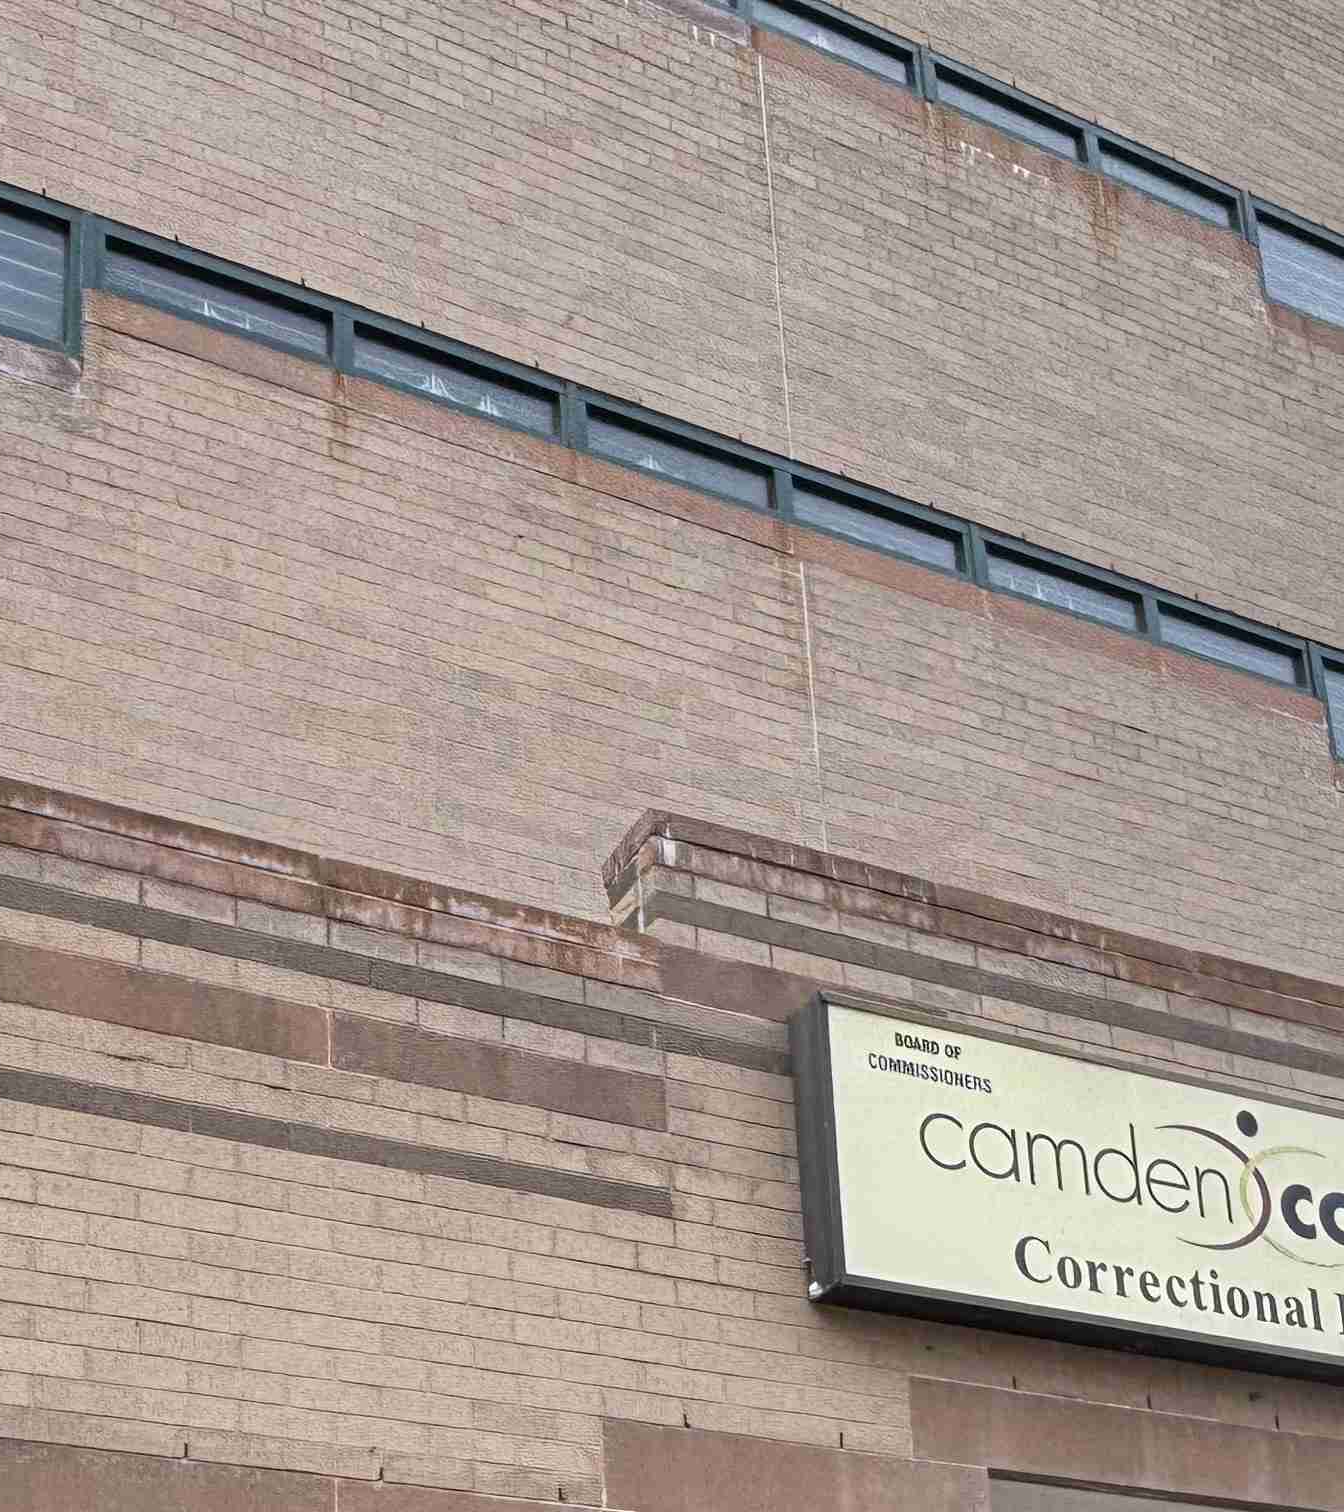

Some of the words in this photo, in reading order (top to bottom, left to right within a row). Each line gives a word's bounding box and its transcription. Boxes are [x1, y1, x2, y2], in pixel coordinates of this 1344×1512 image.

[868, 1052, 993, 1094] COMMISSIONERS
[894, 1031, 940, 1055] BOARD
[944, 1044, 962, 1060] OF
[919, 1112, 1234, 1224] camden
[1013, 1234, 1325, 1332] Correctional
